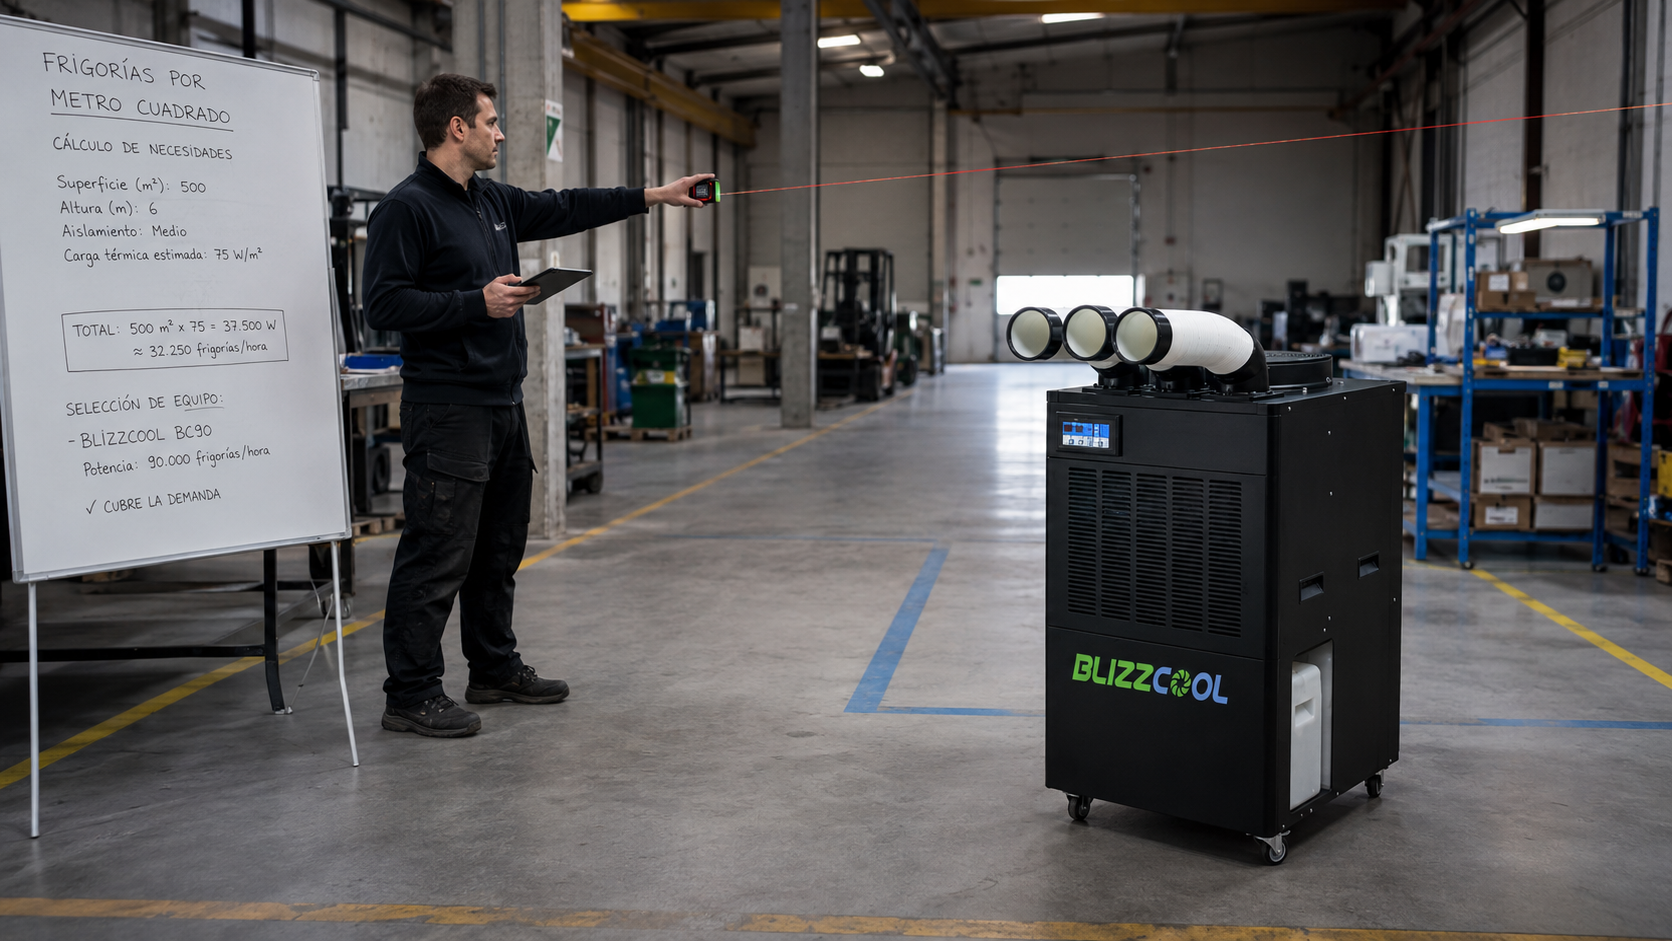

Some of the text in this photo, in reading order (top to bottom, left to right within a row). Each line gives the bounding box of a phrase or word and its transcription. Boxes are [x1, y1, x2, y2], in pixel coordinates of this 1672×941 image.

[43, 53, 205, 90] FRIGORÍAS POR
[51, 89, 230, 123] METRO CUADRADO
[53, 133, 232, 160] CÁLCULO DE NECESIDADES
[57, 175, 206, 194] Superficie (m²): 500
[60, 201, 157, 216] Altura (m): 6
[62, 224, 187, 237] Aislamiento: Medio
[64, 247, 262, 267] Carga térmica estimada: 75 W/m²
[73, 324, 120, 337] TOTAL:
[130, 322, 154, 335] 500
[160, 320, 173, 333] m²
[190, 321, 205, 332] 75
[224, 320, 262, 333] 37.500
[266, 320, 276, 330] W
[150, 344, 191, 357] 32.250
[197, 340, 267, 359] frigorías/hora
[66, 392, 224, 416] SELECCIÓN DE EQUIPO:
[81, 428, 165, 449] BLIZZCOOL
[175, 424, 211, 440] BC90
[84, 447, 270, 477] Potencia: 90.000 frigorías/hora
[104, 488, 221, 513] CUBRE LA DEMANDA
[1072, 653, 1228, 704] BLIZZCOOL
